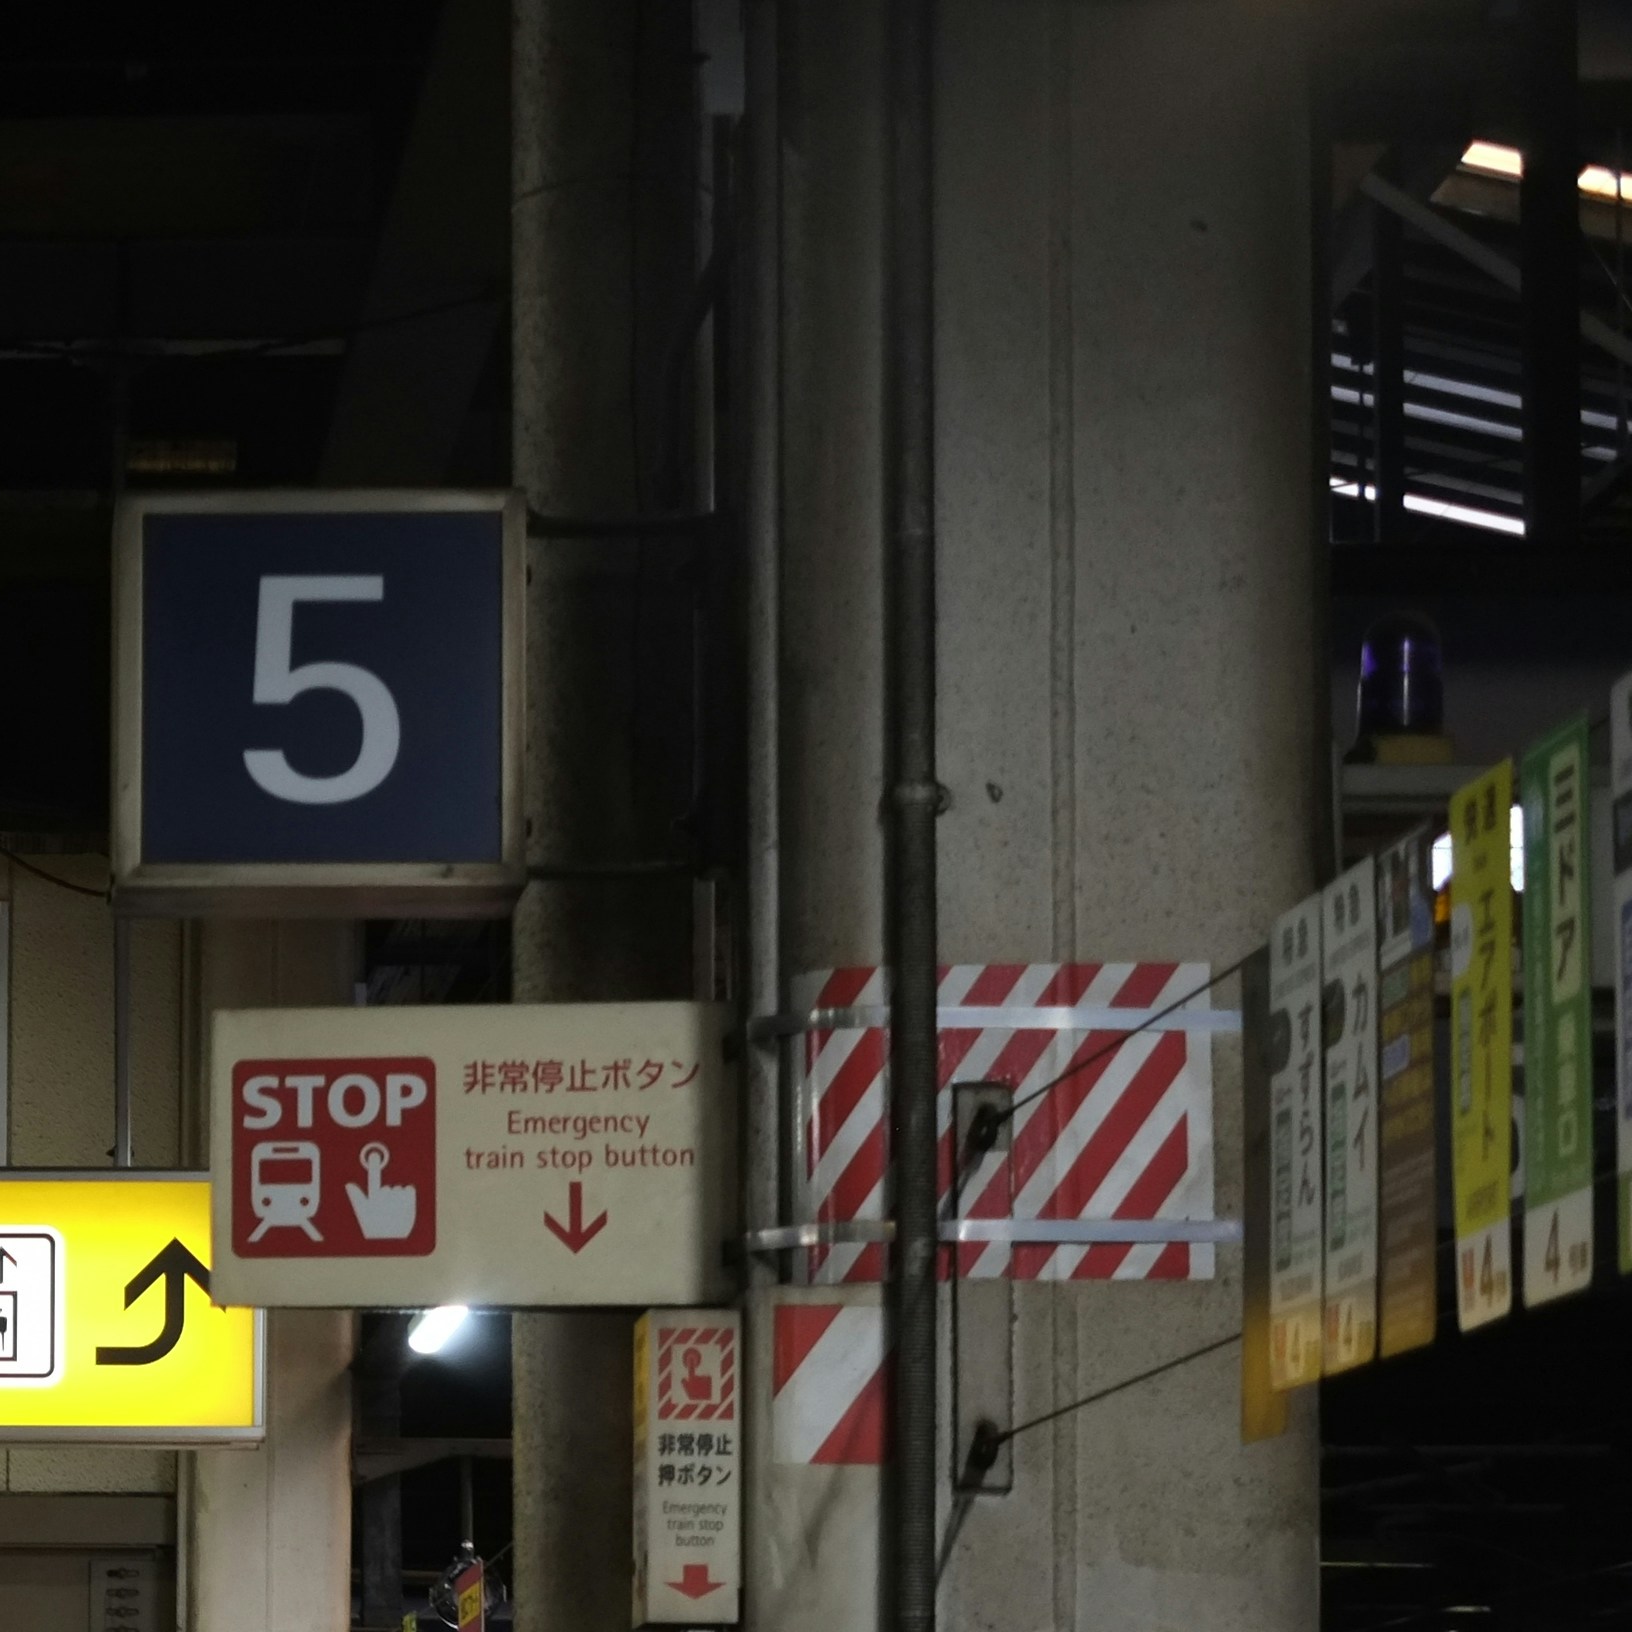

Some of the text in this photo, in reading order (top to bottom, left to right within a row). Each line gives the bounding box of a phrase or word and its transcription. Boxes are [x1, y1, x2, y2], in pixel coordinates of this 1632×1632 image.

[242, 573, 401, 805] 5
[463, 1059, 701, 1096] 非常停止ボタン
[241, 1072, 429, 1131] STOP
[506, 1110, 650, 1141] Emergency
[465, 1143, 697, 1175] train stop button
[657, 1433, 734, 1456] 非常停止
[657, 1463, 733, 1486] 押ボタン
[662, 1500, 729, 1518] Emergency
[666, 1519, 725, 1533] train stop
[675, 1534, 717, 1547] button
